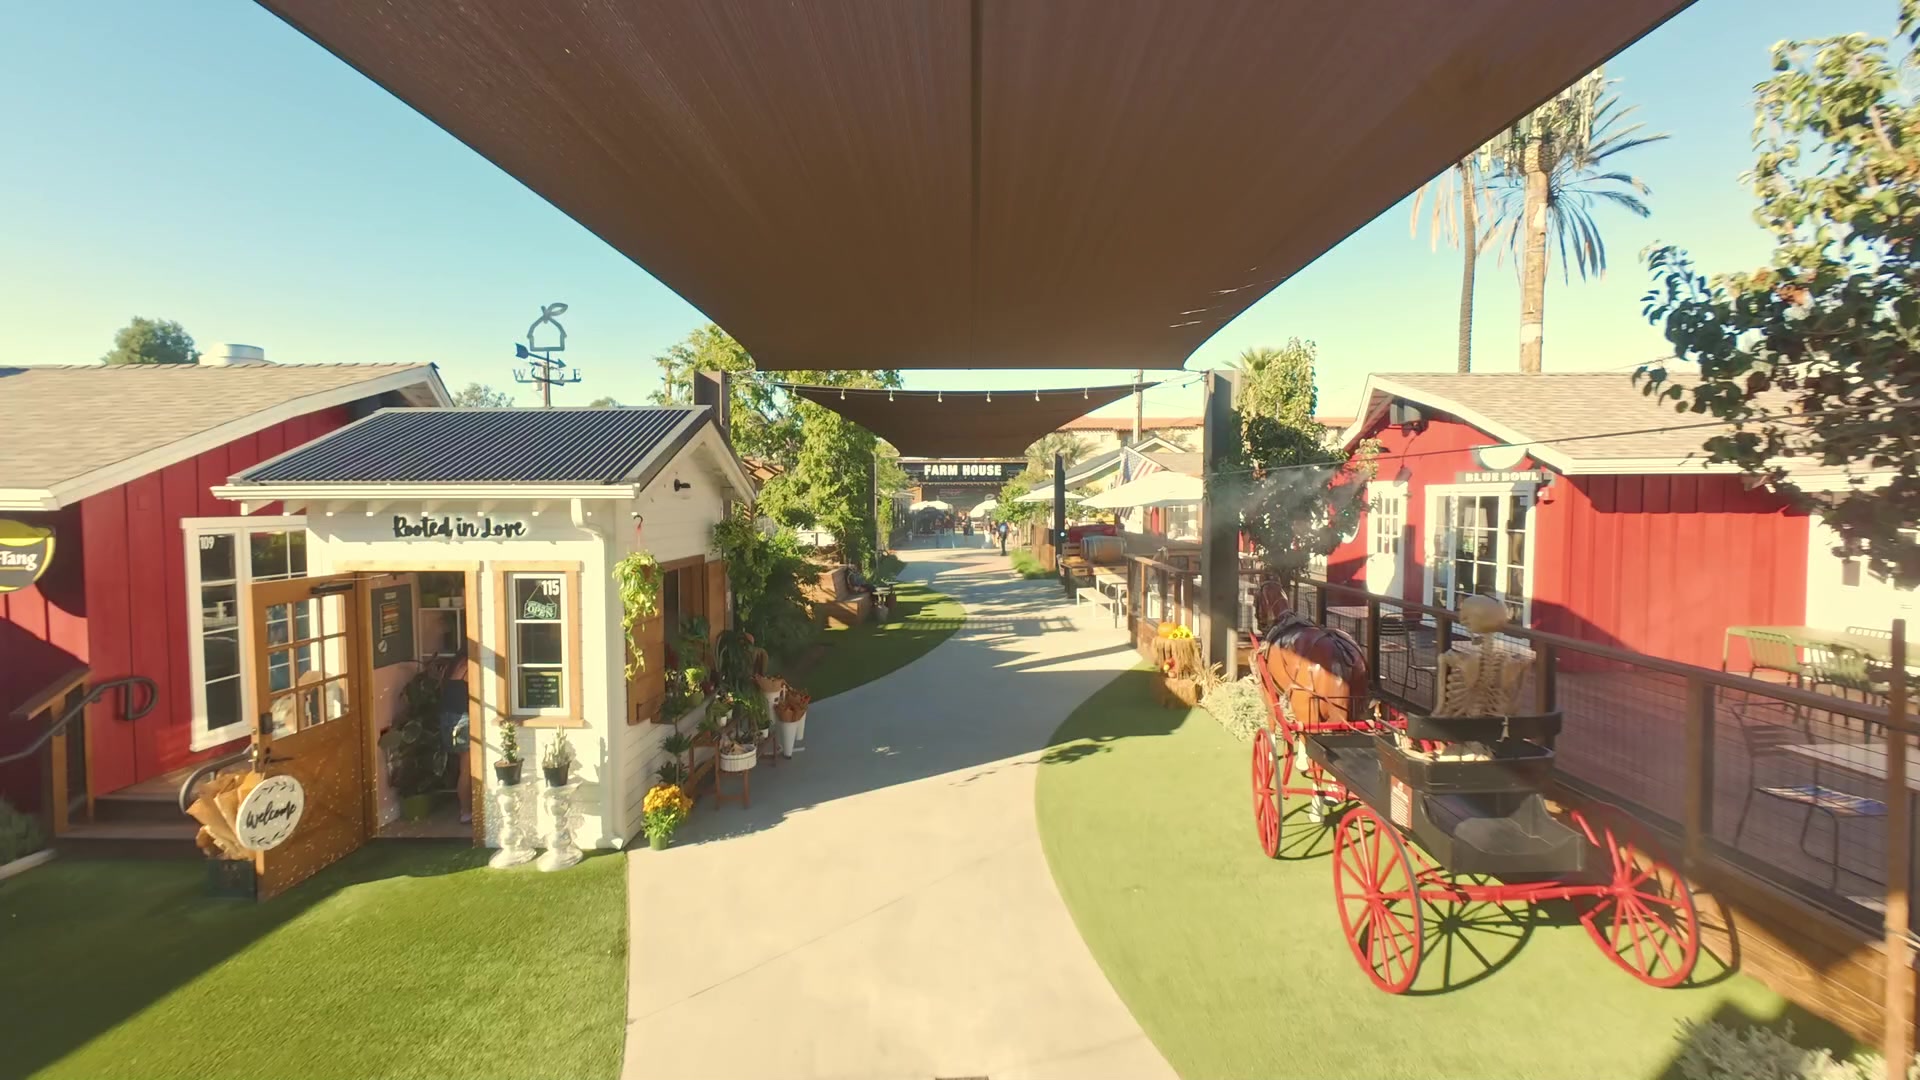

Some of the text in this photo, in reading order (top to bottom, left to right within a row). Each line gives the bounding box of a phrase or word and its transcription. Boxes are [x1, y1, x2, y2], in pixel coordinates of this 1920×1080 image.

[924, 464, 1002, 476] FARM HOUSE
[1465, 471, 1539, 482] BLUE BOWL
[393, 515, 526, 538] Rooted in Love
[541, 579, 560, 596] 115
[527, 604, 554, 618] OPEN
